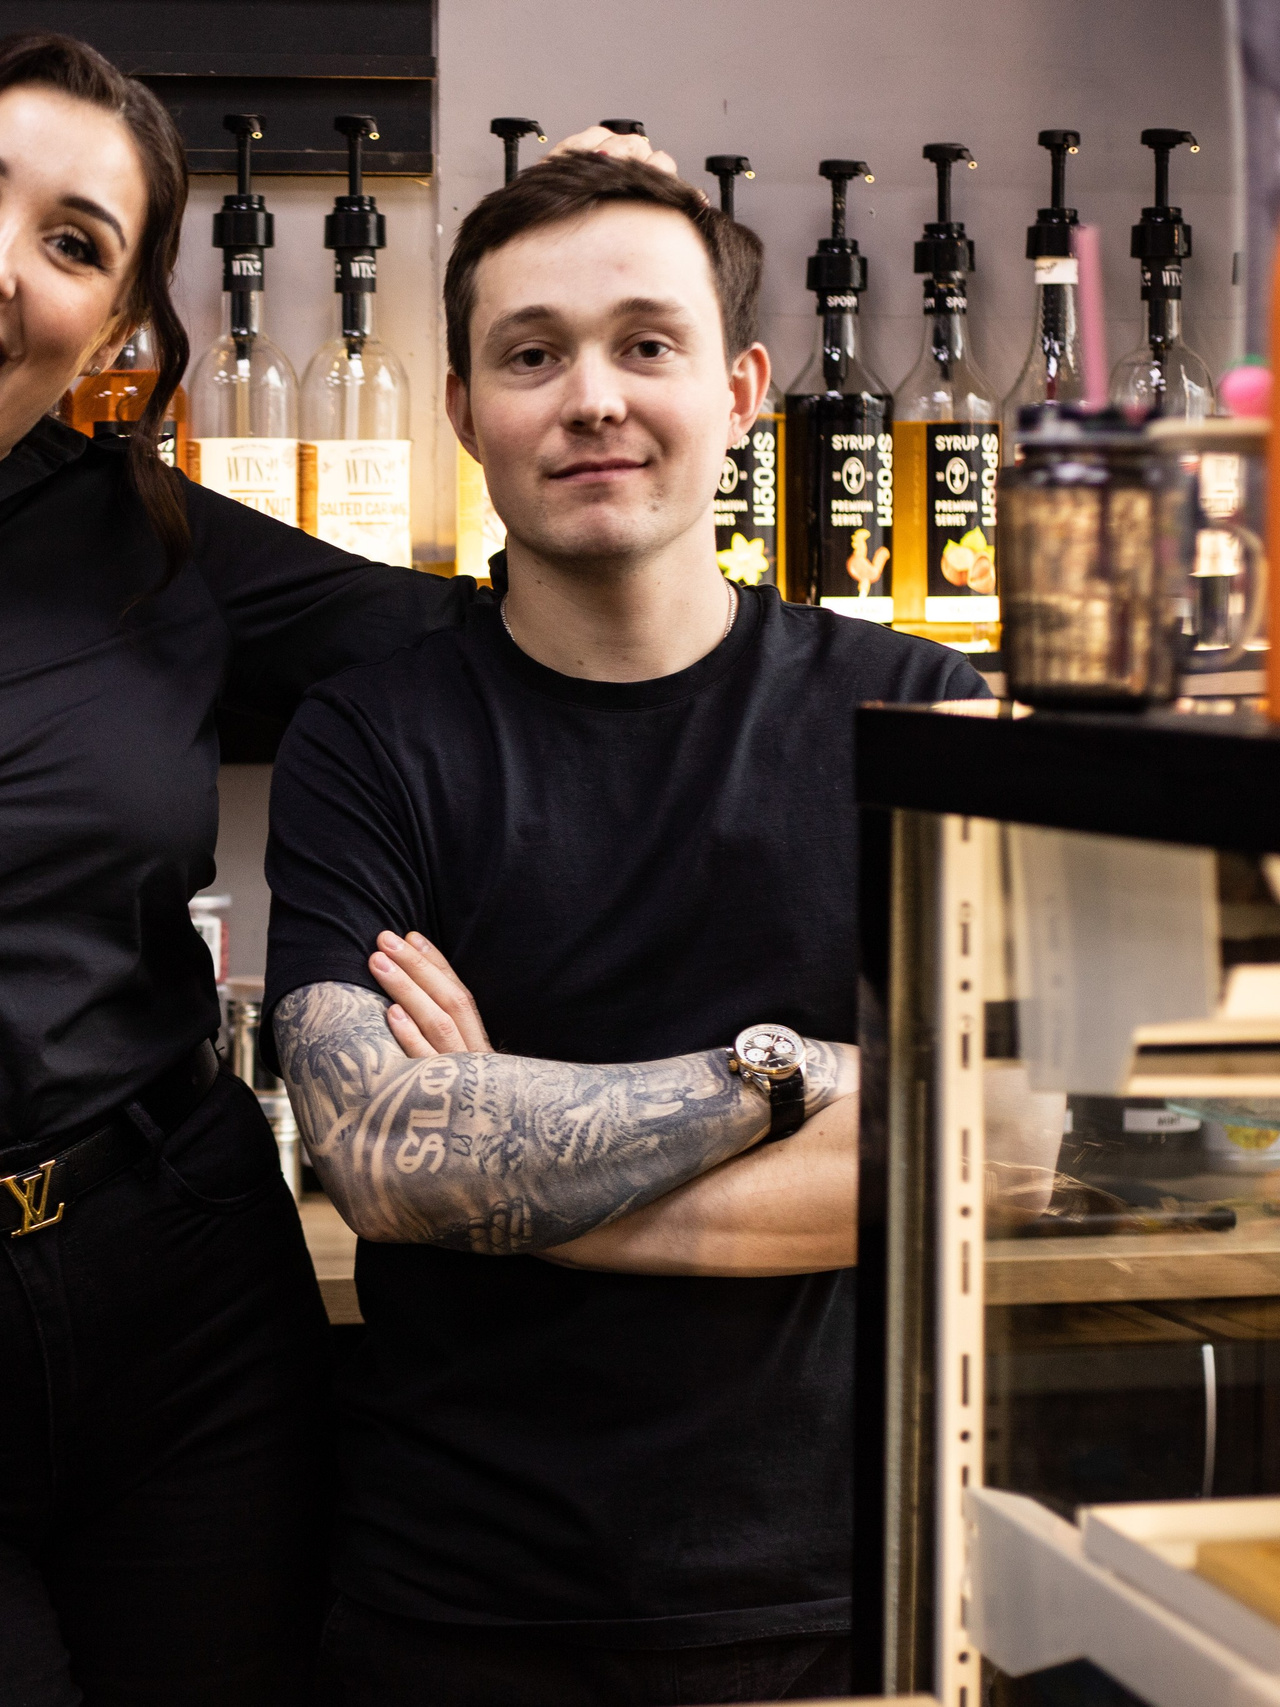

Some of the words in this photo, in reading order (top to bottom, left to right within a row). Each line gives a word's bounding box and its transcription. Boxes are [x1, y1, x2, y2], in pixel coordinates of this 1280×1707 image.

[831, 434, 876, 451] SYRUP
[934, 434, 980, 451] SYRUP
[831, 499, 874, 513] PREMIUM
[934, 499, 979, 513] PREMIUM
[831, 513, 863, 527] SERIES
[934, 513, 967, 527] SERIES
